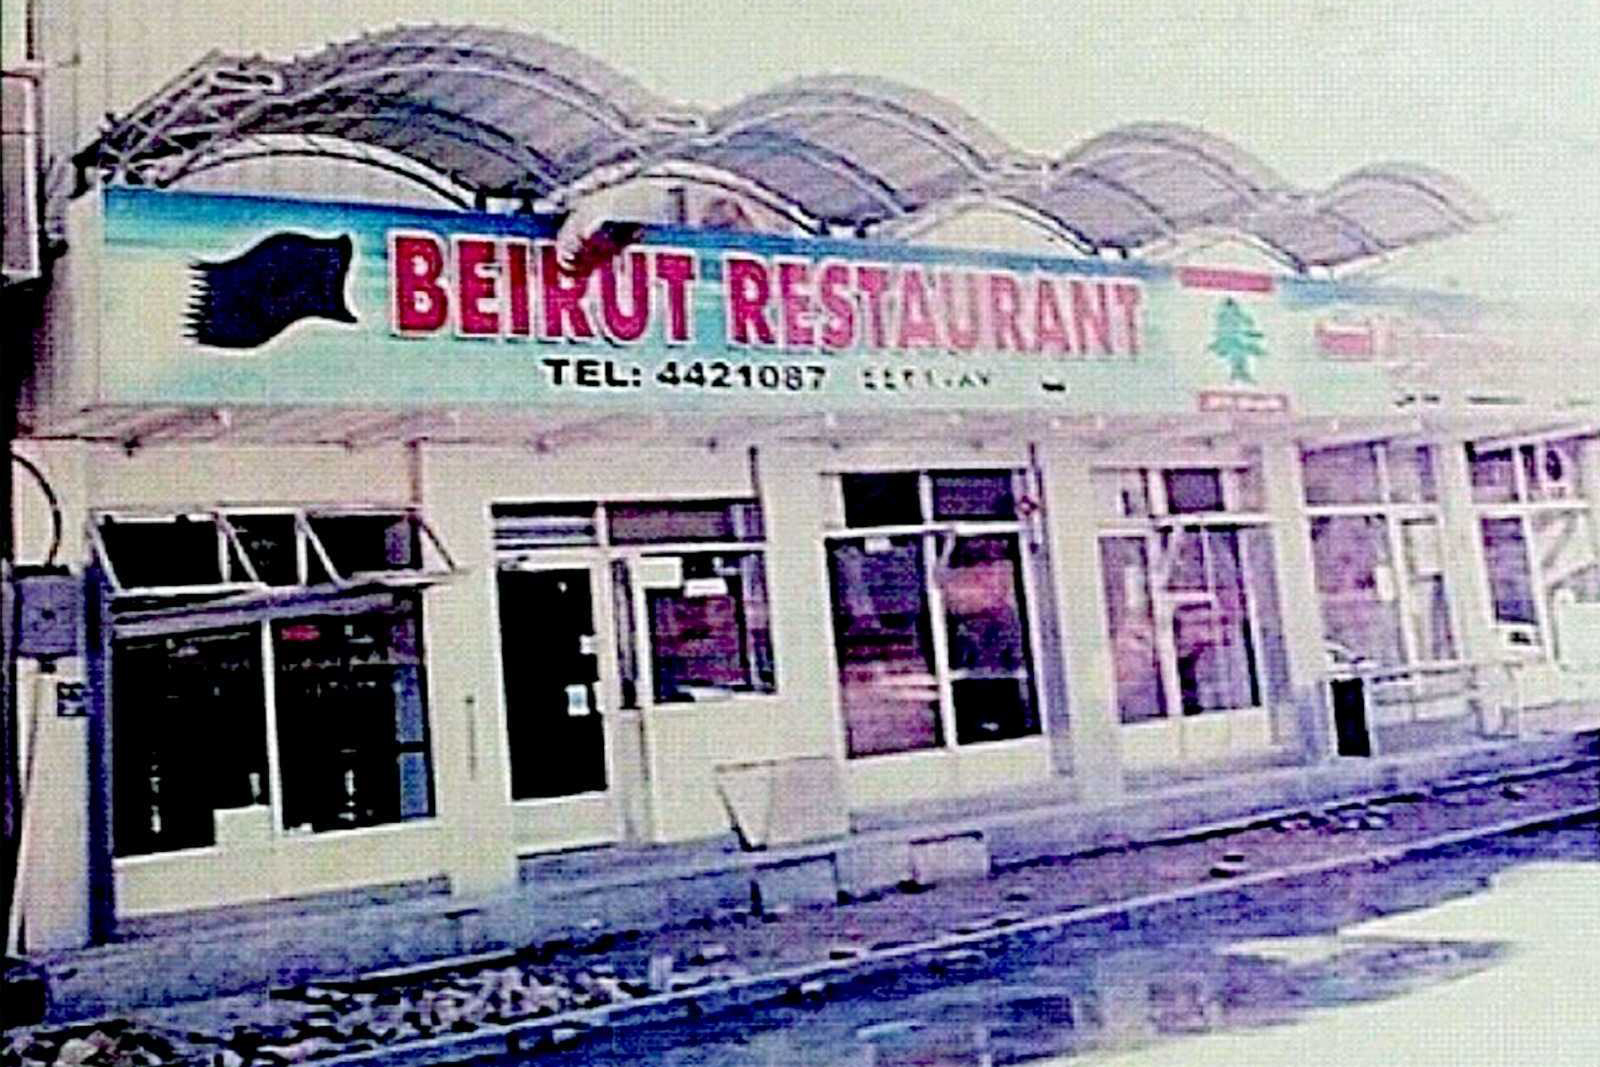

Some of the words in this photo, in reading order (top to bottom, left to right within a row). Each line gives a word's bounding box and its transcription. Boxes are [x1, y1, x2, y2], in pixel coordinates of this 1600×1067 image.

[388, 231, 697, 345] BEIRUT
[724, 255, 1143, 357] RESTAURANT
[543, 358, 641, 388] TEL:
